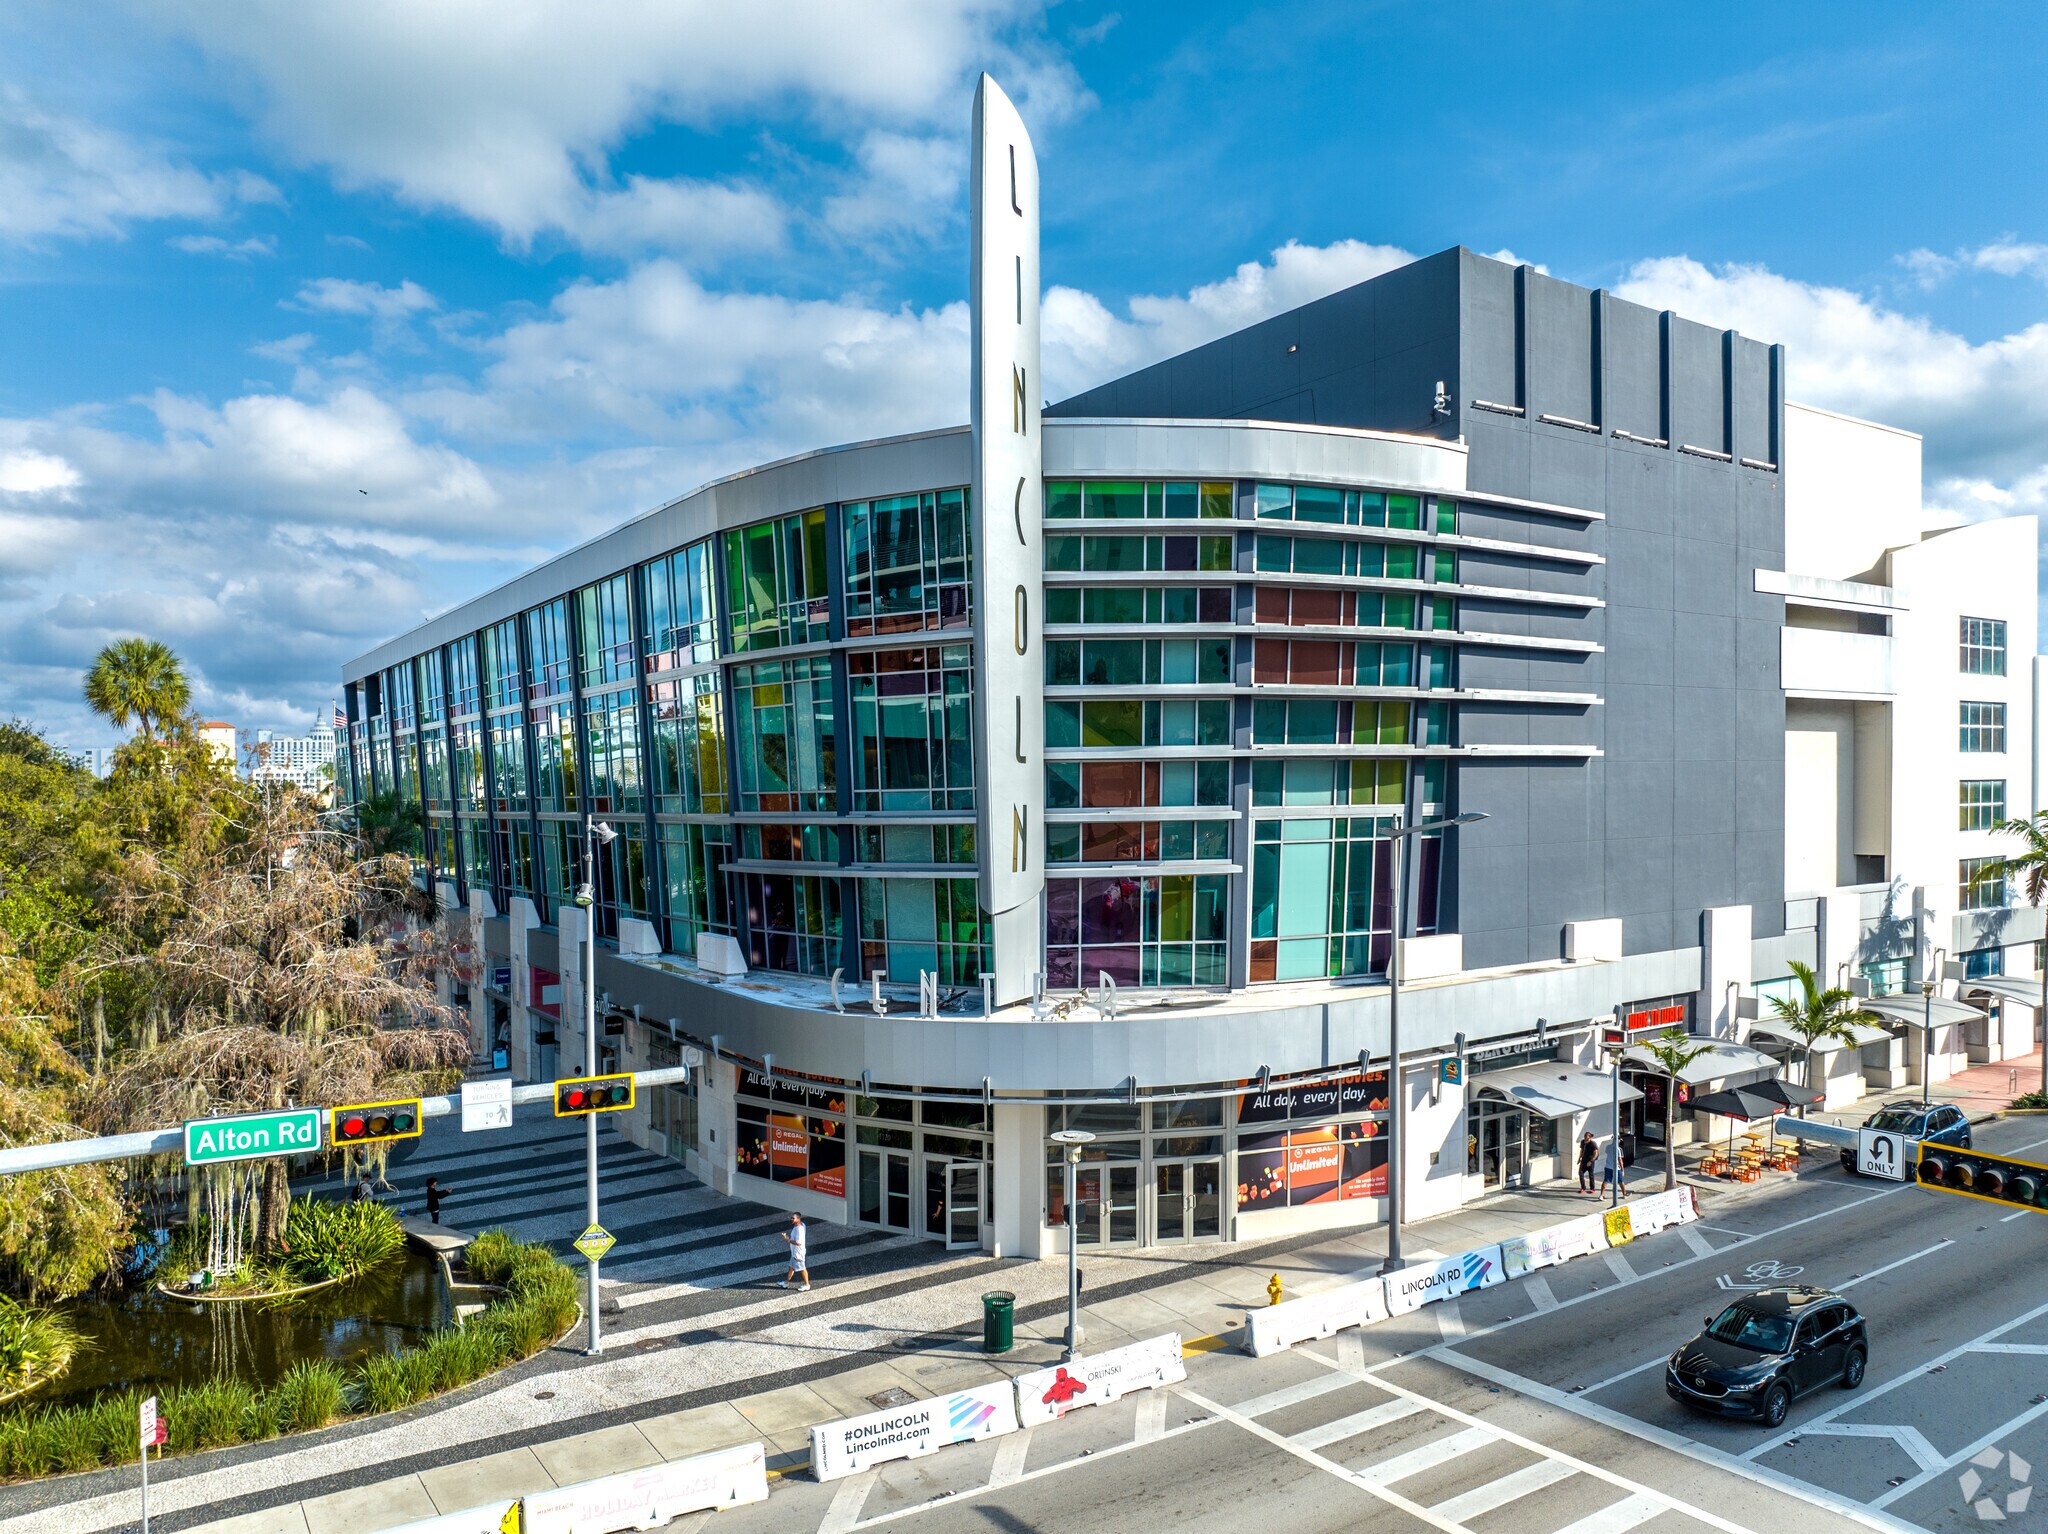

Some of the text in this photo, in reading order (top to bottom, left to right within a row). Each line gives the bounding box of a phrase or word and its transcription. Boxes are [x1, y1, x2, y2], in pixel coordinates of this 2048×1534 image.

[1008, 143, 1029, 873] LINCOLN
[831, 967, 1117, 1021] CENTER
[1628, 1005, 1685, 1031] WOK TO WALK
[473, 1084, 501, 1094] TURNING
[747, 1072, 759, 1085] All
[781, 1081, 806, 1096] every
[472, 1092, 503, 1101] VEHICLES
[1253, 1087, 1366, 1109] All day, every day.
[196, 1119, 312, 1155] Alton Rd
[783, 1131, 803, 1139] REGAL
[772, 1140, 807, 1154] Unlimited
[1305, 1146, 1333, 1154] REGAL
[1290, 1154, 1338, 1173] Unlimited
[1867, 1161, 1895, 1175] ONLY
[1402, 1272, 1446, 1295] LINCOLN
[1447, 1268, 1461, 1282] RD
[1087, 1364, 1122, 1382] ORLINSKI
[844, 1411, 930, 1442] #ONLINCOLN
[846, 1426, 930, 1455] LincolnRd.com
[537, 1502, 574, 1515] MIAMI BEACH
[579, 1487, 652, 1521] HOLIDAY
